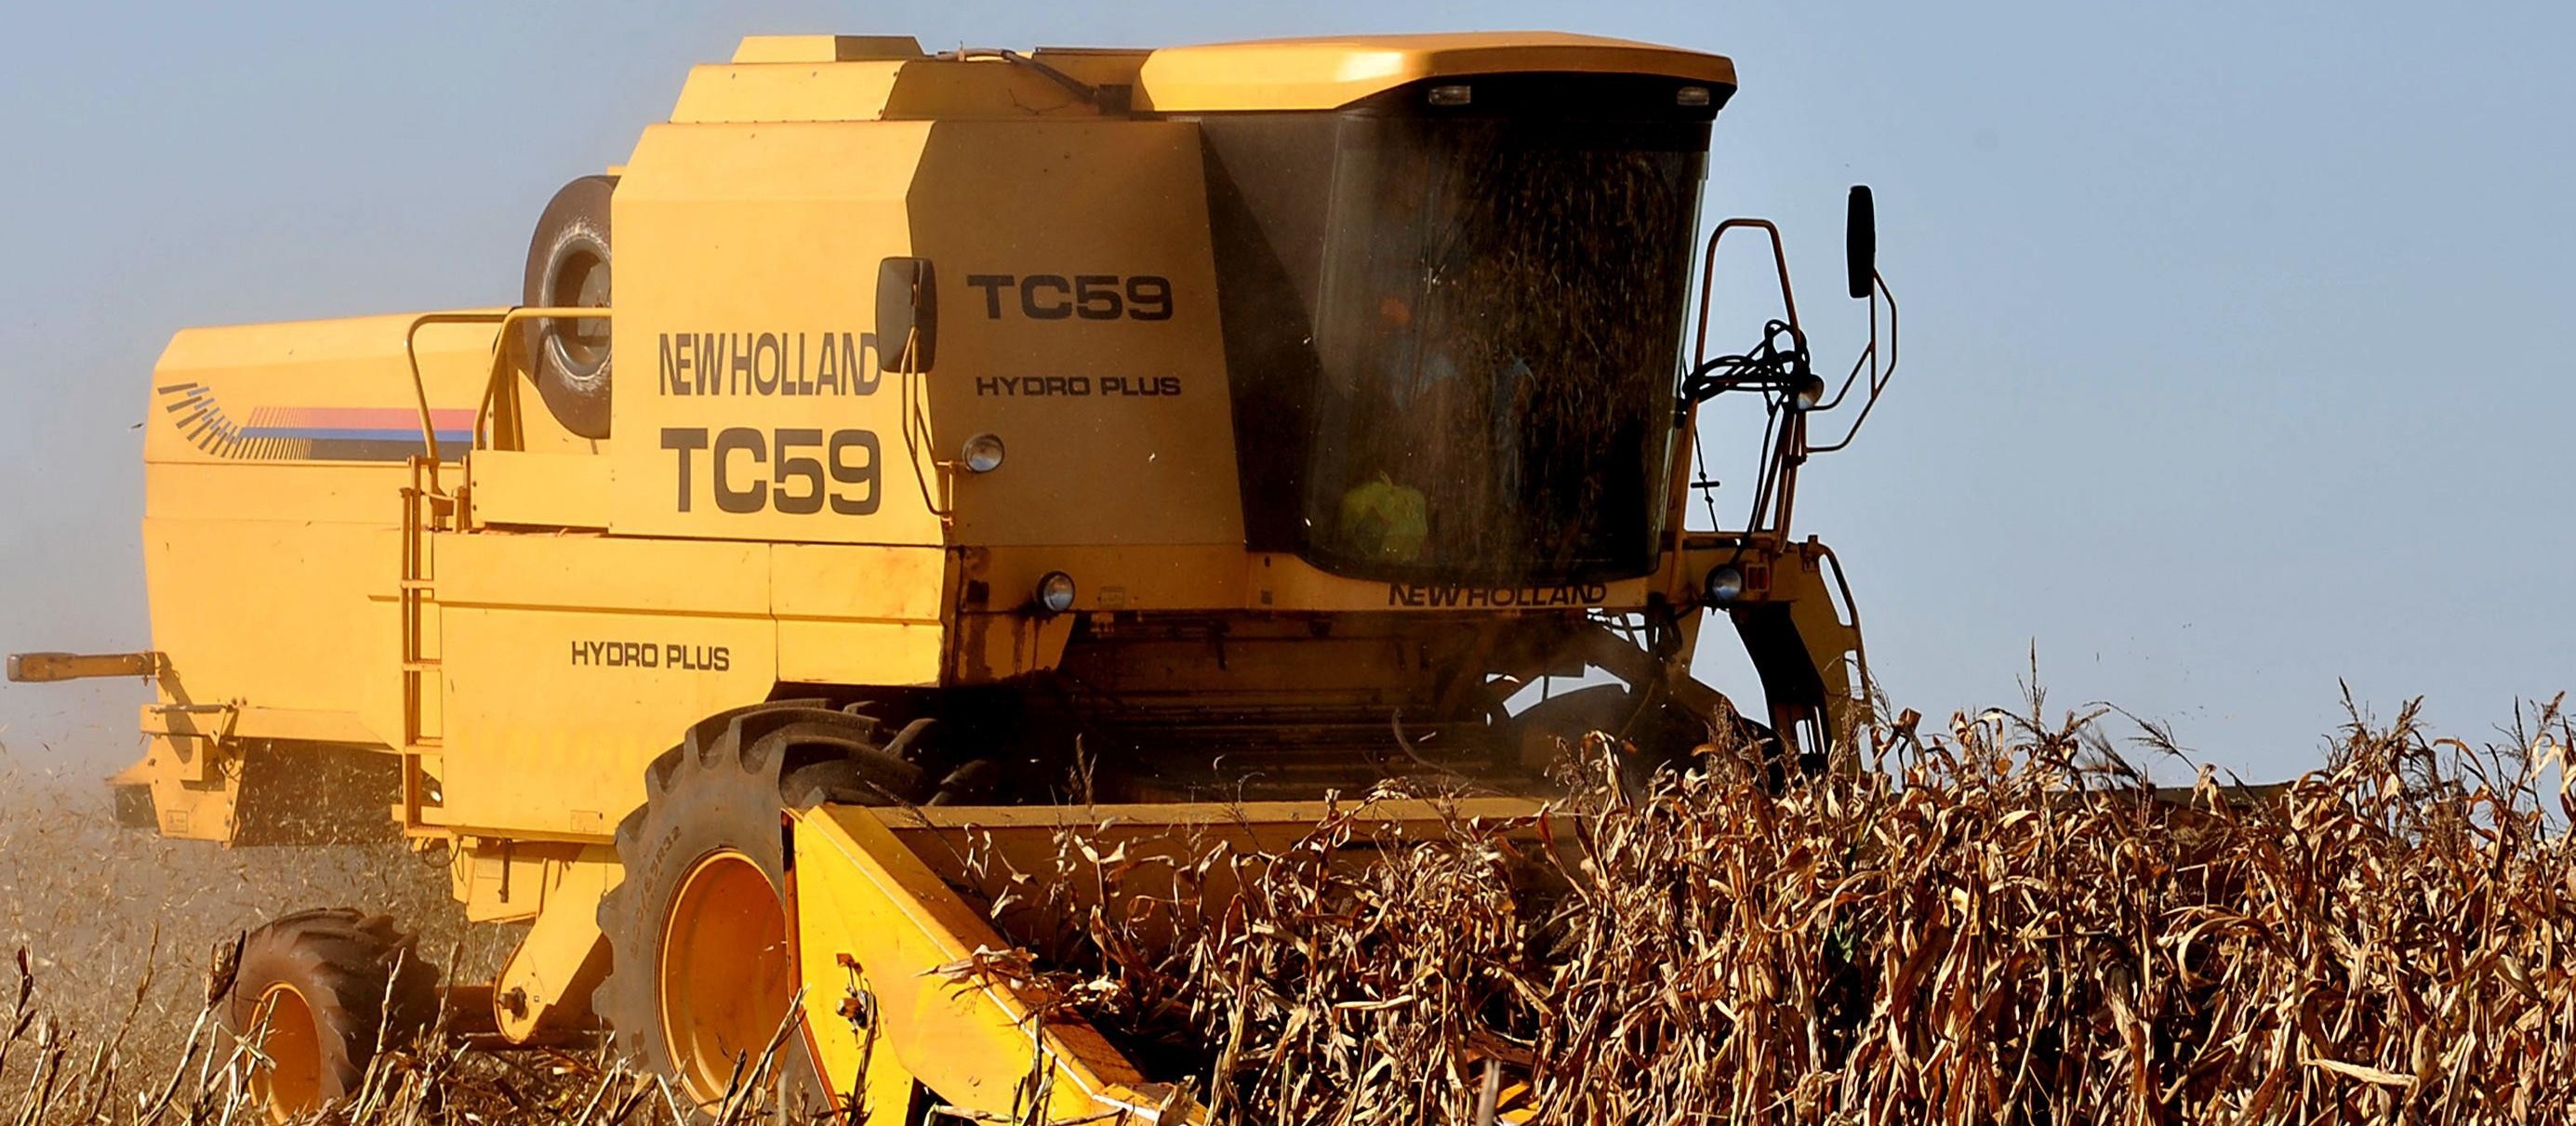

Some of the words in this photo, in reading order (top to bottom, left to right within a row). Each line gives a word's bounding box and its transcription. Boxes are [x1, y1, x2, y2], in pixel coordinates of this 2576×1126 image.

[966, 274, 1173, 321] TC59
[659, 332, 725, 395] NEW
[731, 332, 883, 395] HOLLAND
[976, 377, 1090, 396] HYDRO
[1100, 377, 1181, 396] PLUS
[660, 427, 881, 515] TC59
[1388, 583, 1461, 607] NEW
[1467, 583, 1607, 607] HOLLAND
[571, 641, 658, 668] HYDRO
[666, 644, 730, 671] PLUS
